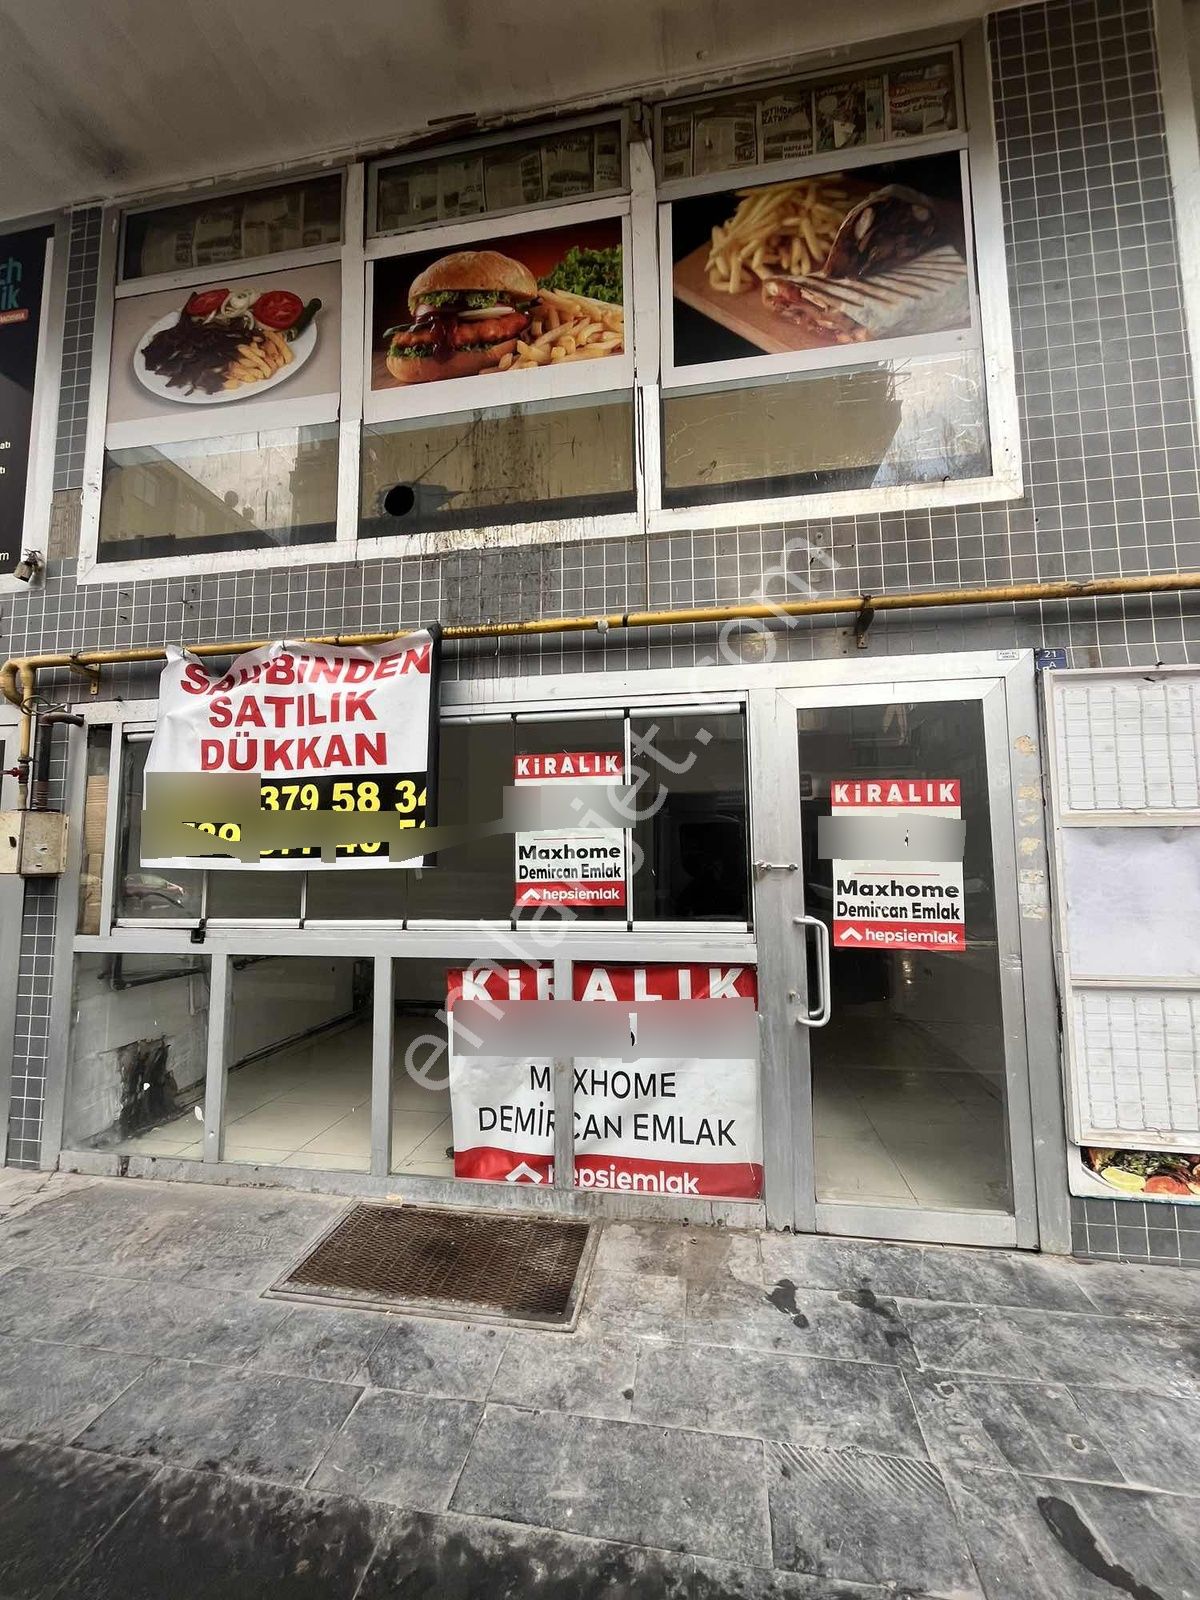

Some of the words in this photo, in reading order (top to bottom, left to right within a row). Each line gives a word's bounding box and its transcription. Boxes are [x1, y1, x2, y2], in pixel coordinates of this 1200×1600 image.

[1044, 650, 1057, 658] 21
[208, 688, 378, 728] SATILIK
[200, 731, 388, 772] DÜKKAN
[260, 783, 319, 811] 379
[332, 782, 381, 812] 58
[518, 844, 621, 861] Maxhome
[519, 863, 579, 880] Demircan
[581, 862, 621, 879] Emlak
[543, 887, 620, 901] hepsiemlak
[836, 879, 960, 898] Maxhome
[836, 901, 908, 919] Demircan
[912, 903, 960, 920] Emlak
[865, 928, 959, 944] hepsiemlak
[530, 1065, 677, 1099] MXHOME
[633, 1113, 736, 1146] EMLAK
